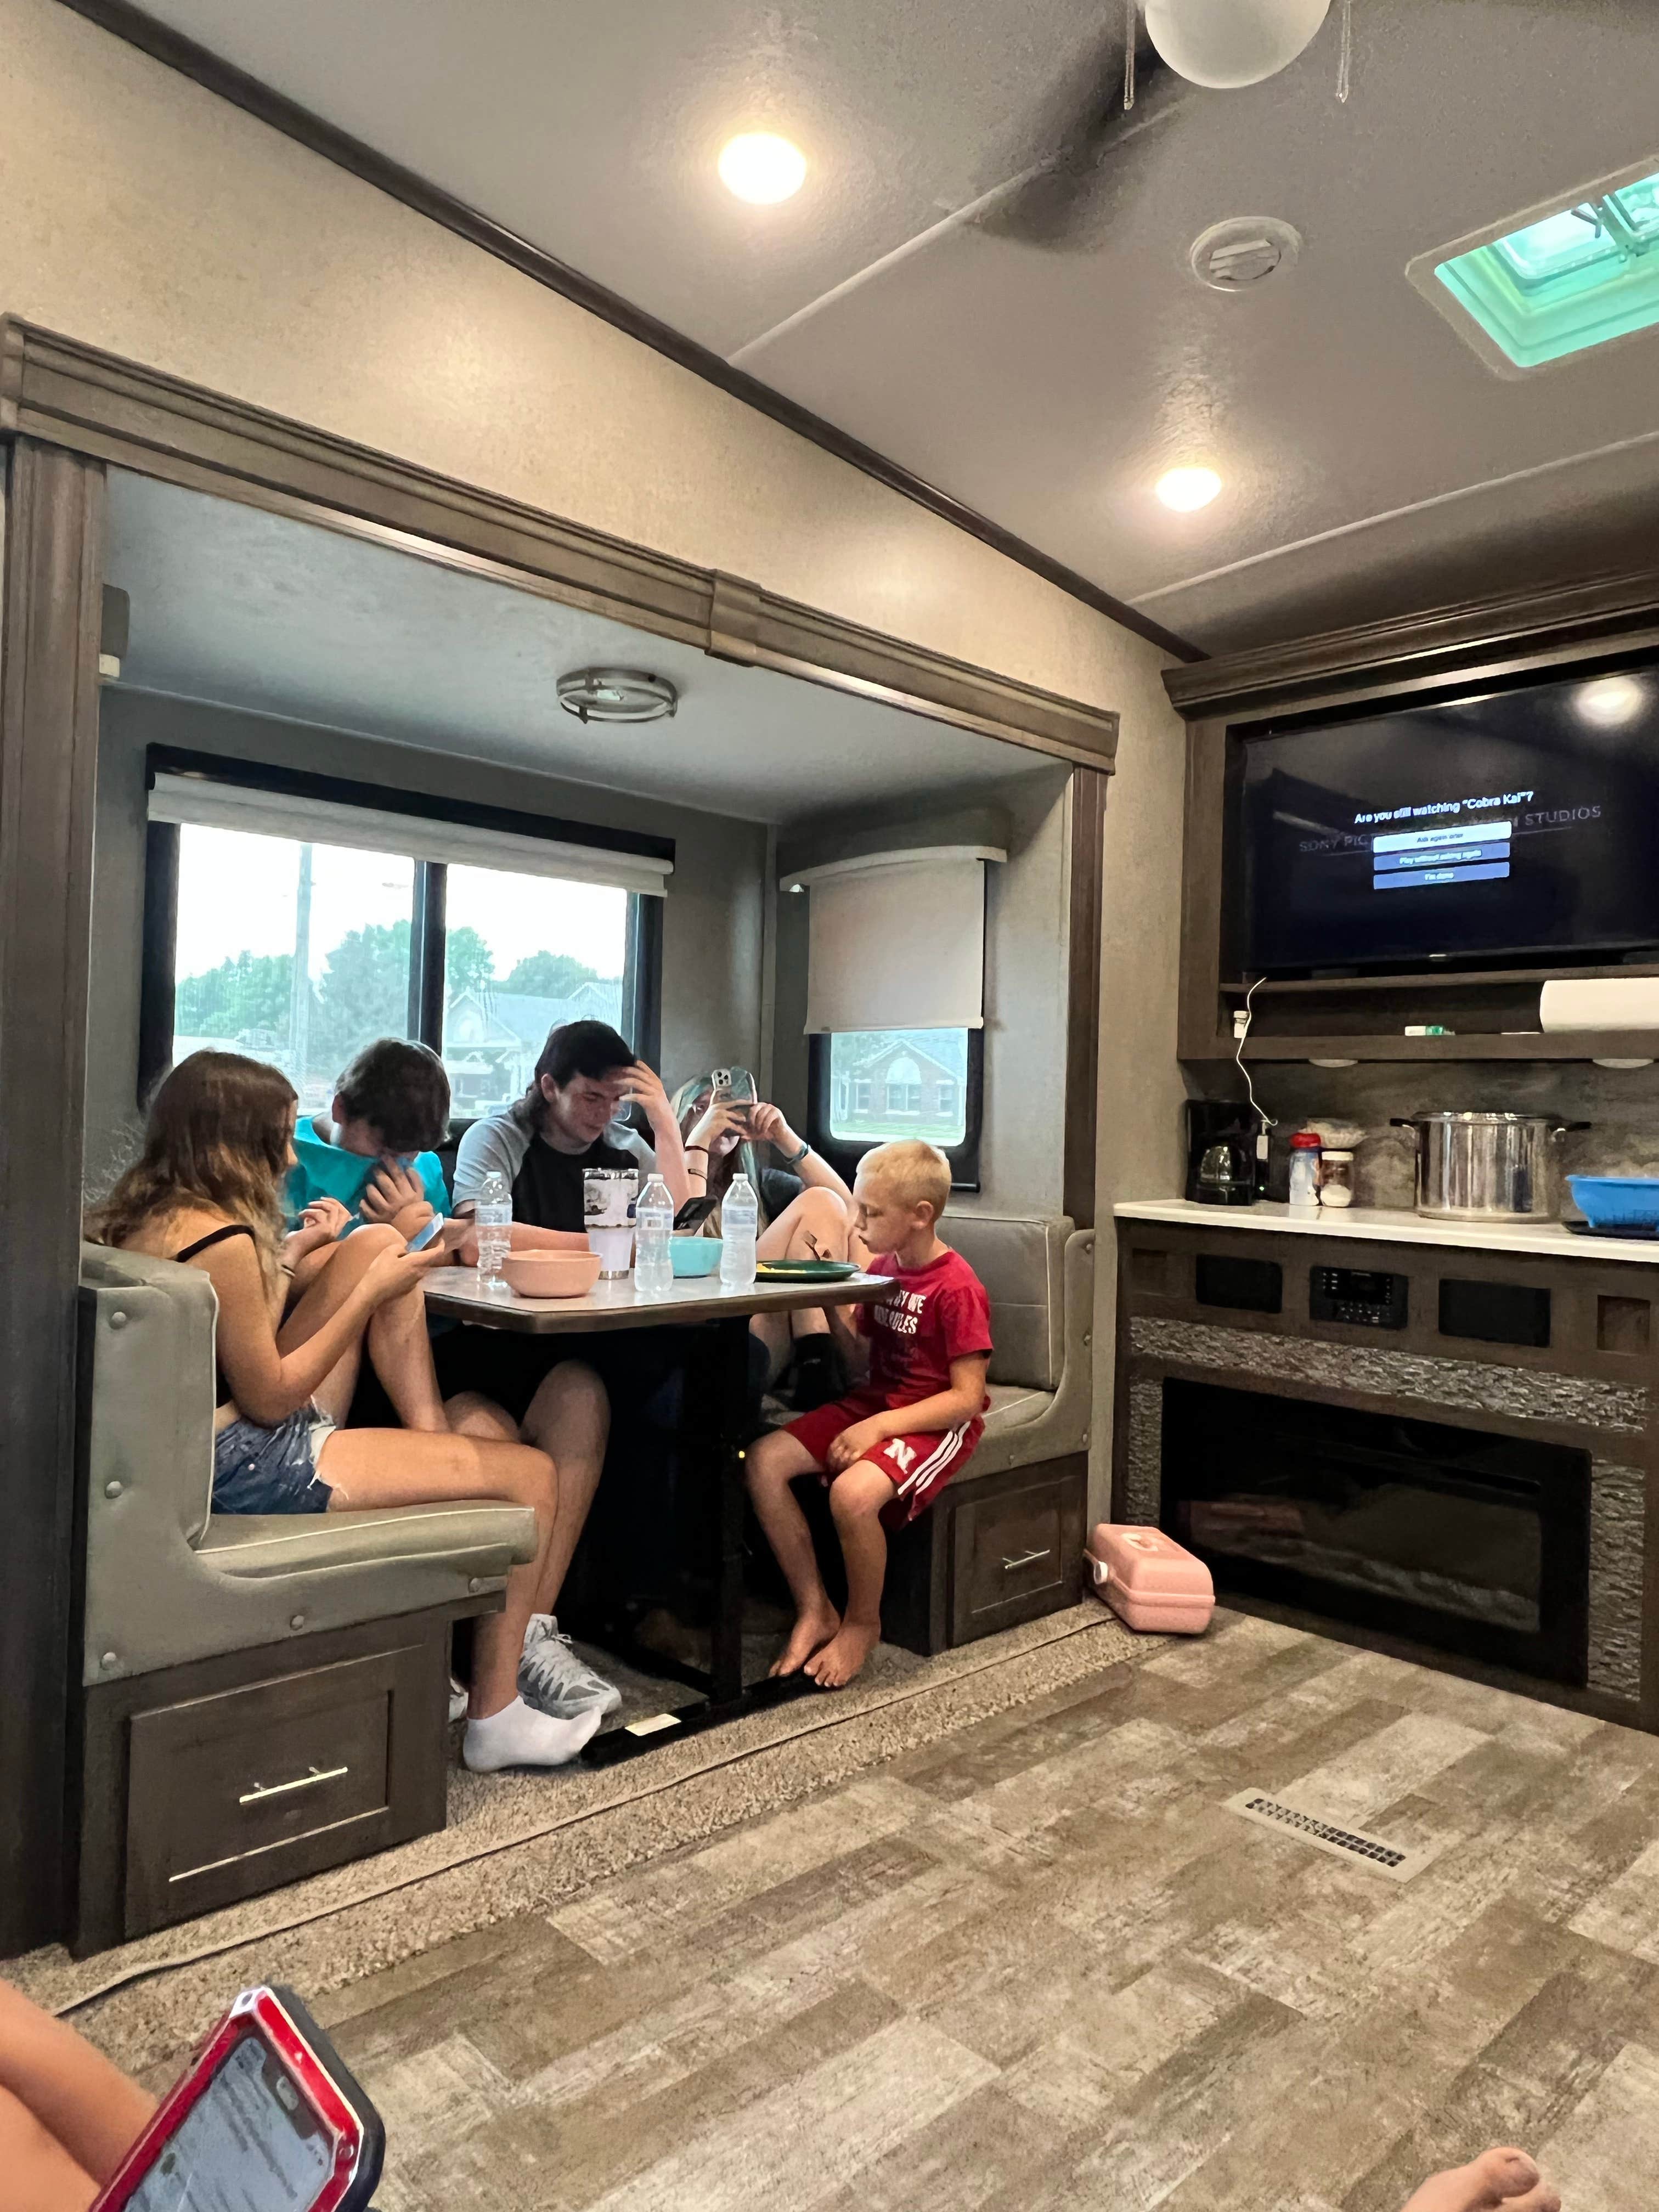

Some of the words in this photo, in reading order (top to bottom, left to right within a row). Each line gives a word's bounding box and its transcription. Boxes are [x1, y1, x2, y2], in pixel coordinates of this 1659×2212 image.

[1354, 814, 1373, 823] Are
[1374, 811, 1392, 823] you
[1393, 806, 1412, 819] still
[1413, 802, 1460, 816] watching
[1462, 797, 1502, 809] "Cobra
[1503, 791, 1534, 805] Kai"?
[1525, 805, 1601, 826] STUDIOS
[883, 1438, 917, 1475] N
